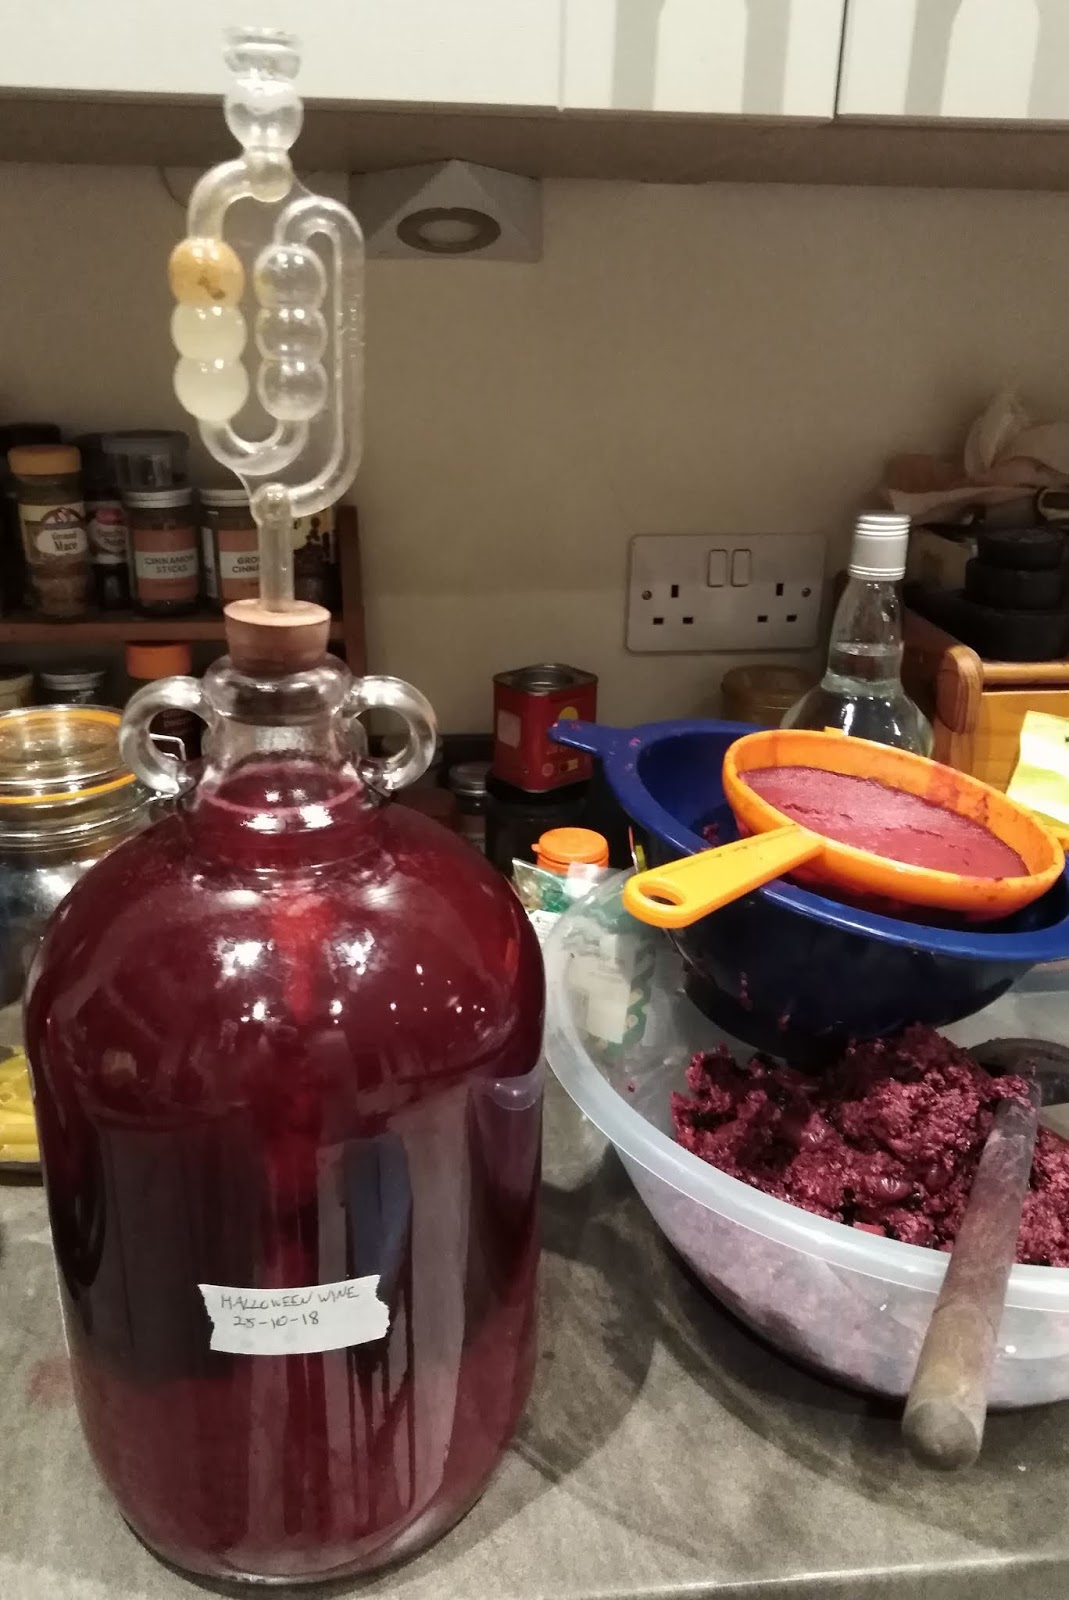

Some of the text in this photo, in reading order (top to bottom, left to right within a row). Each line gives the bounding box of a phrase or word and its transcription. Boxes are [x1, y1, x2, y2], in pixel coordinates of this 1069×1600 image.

[54, 541, 78, 551] Mace
[237, 556, 260, 565] GRO
[156, 564, 188, 574] STICKS
[220, 1285, 360, 1311] HALLOWEEN WINE
[233, 1310, 320, 1329] 25-10-18
